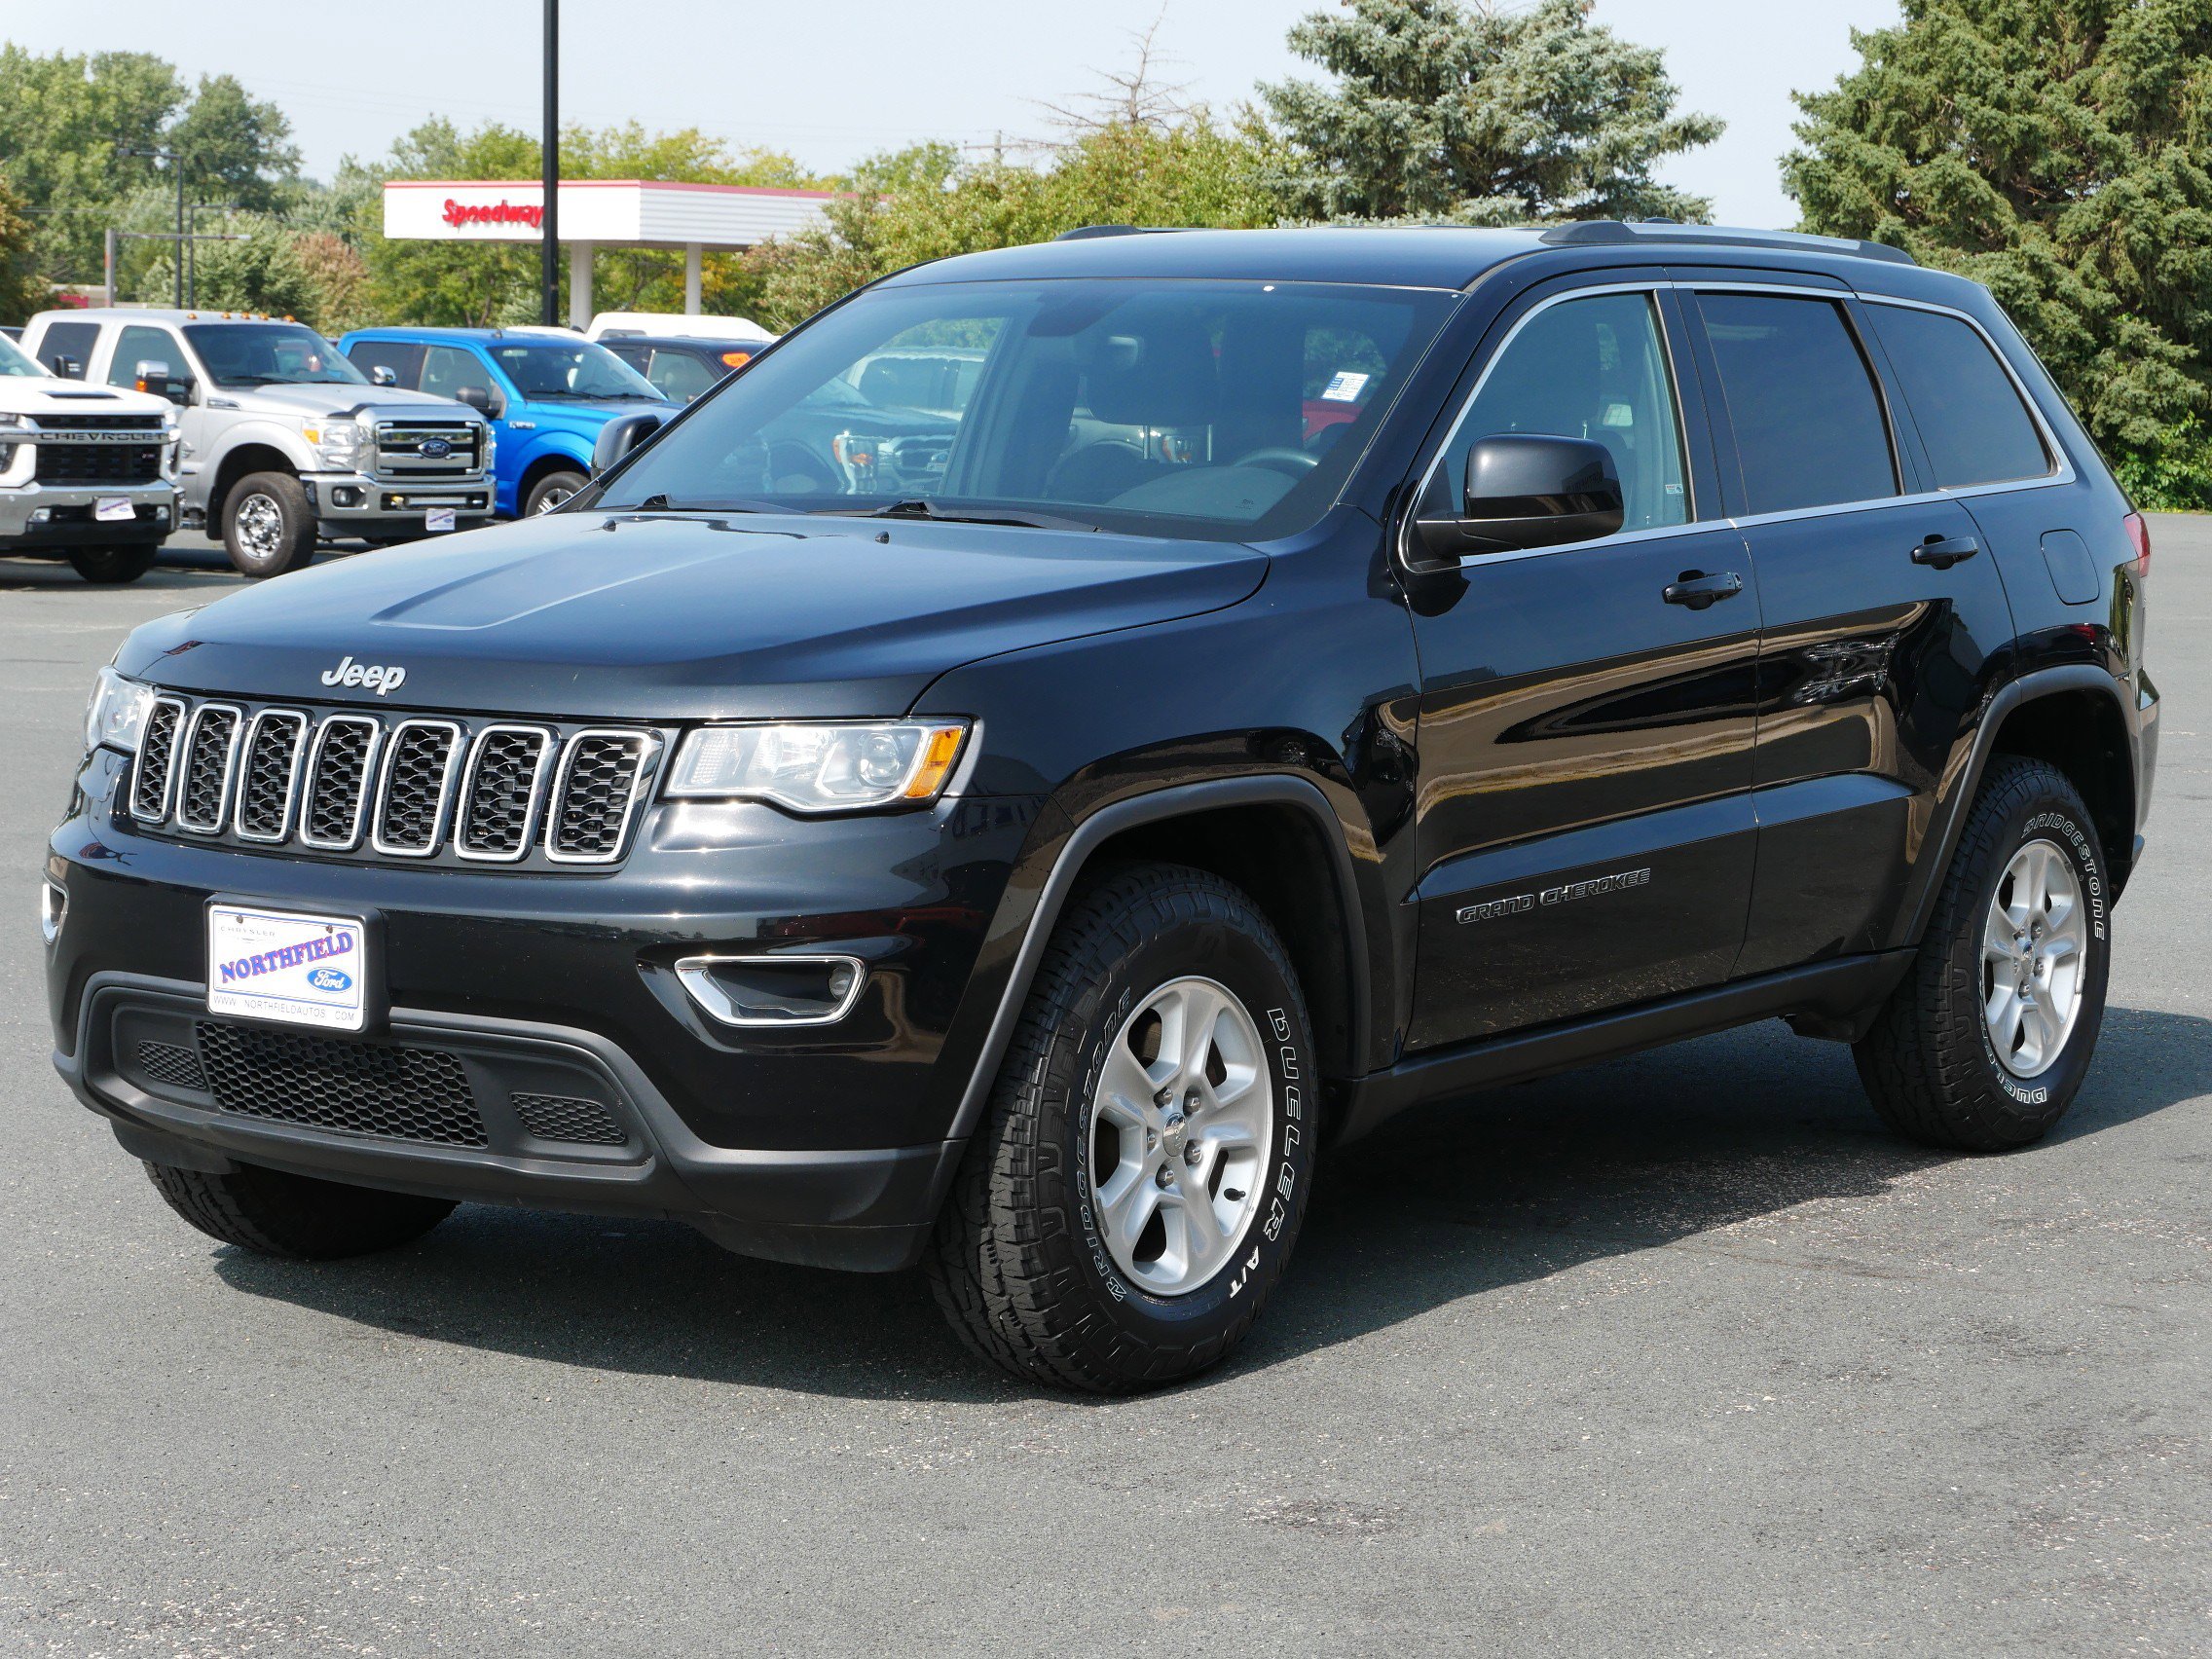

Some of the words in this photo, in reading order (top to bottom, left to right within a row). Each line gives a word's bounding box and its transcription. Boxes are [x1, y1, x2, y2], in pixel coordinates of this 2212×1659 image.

[442, 199, 544, 228] Speedway
[40, 432, 165, 441] CHEVROLET
[321, 656, 407, 697] Jeep
[1456, 894, 1535, 925] GRAND
[1539, 867, 1651, 906] CHEROKEE
[2020, 812, 2105, 940] BRIDGESTONE
[219, 931, 354, 984] NORTHFIELD
[313, 968, 345, 990] Ford
[1076, 986, 1131, 1303] BRIDGESTONE
[1265, 1007, 1302, 1242] DUELER
[1229, 1245, 1261, 1299] A/T
